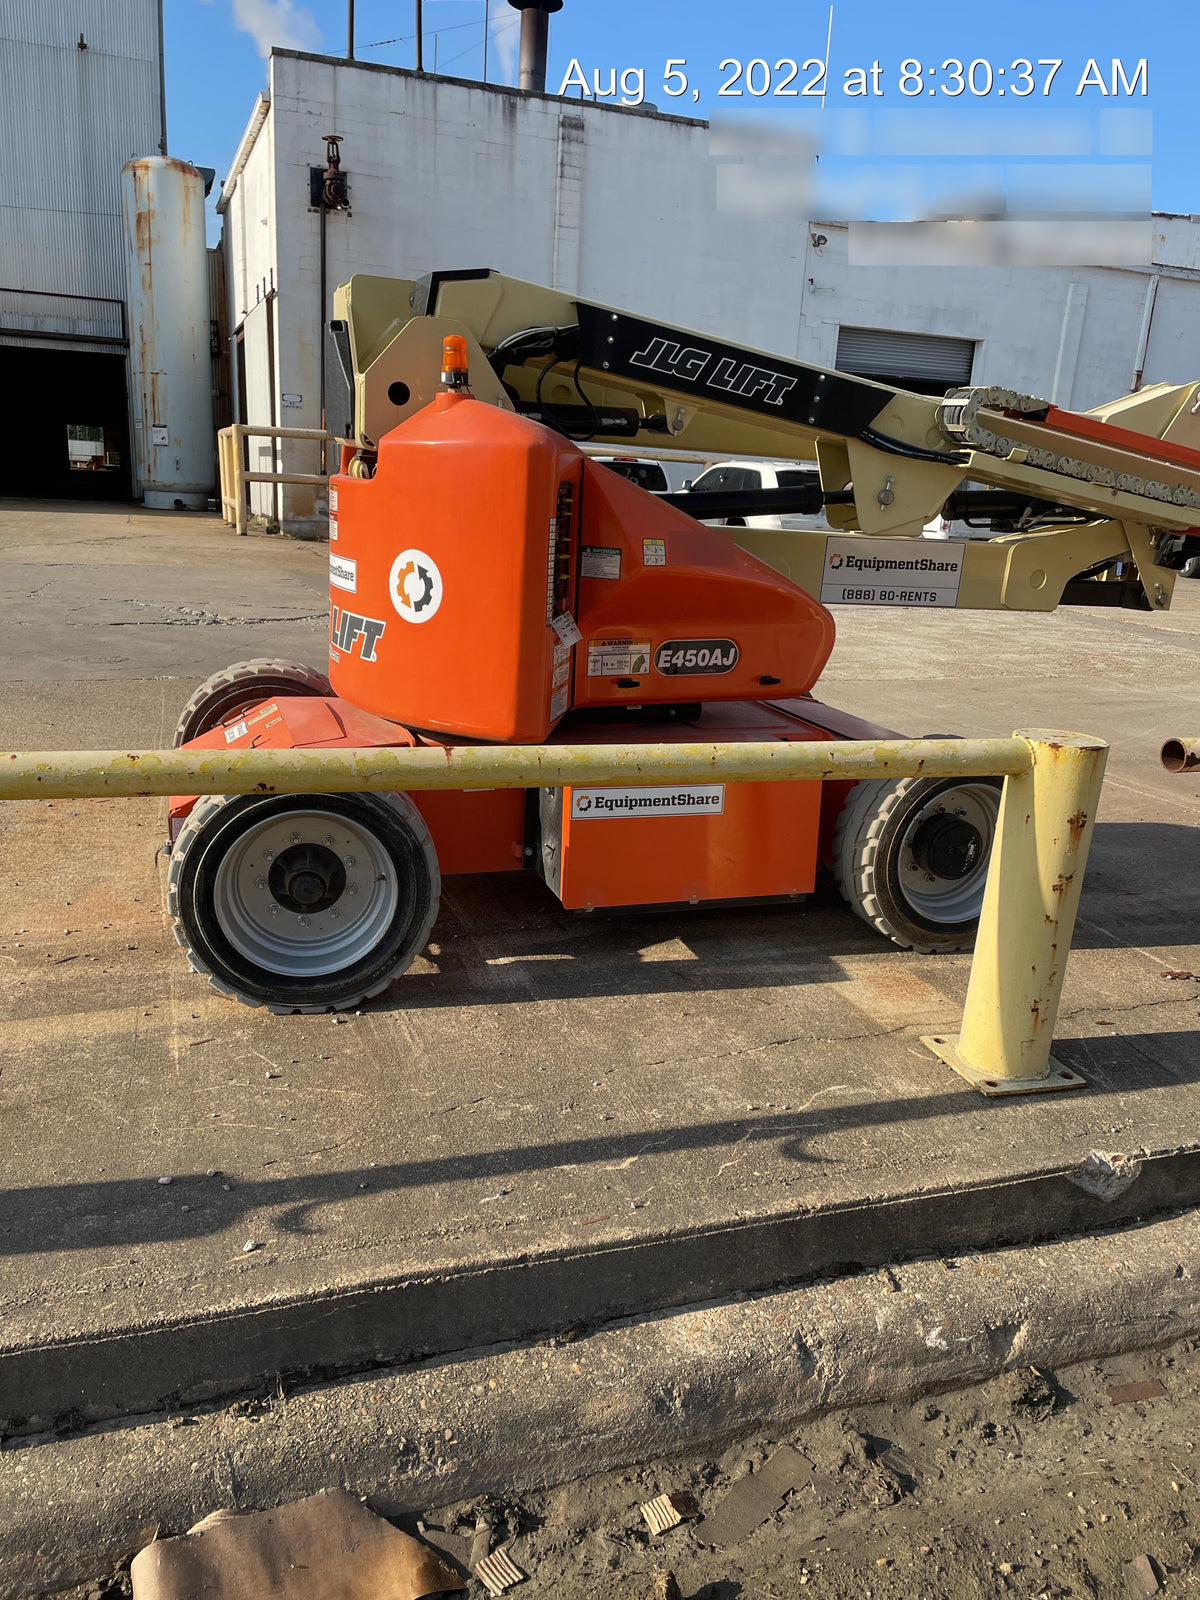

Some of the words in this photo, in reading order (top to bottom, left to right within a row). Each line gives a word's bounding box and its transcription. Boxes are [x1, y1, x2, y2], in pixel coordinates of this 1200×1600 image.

[629, 337, 712, 381] JLG
[706, 357, 798, 406] LIFT
[845, 555, 958, 572] EquipmentShare
[842, 588, 876, 601] (888)
[879, 590, 937, 602] 80-RENTS
[331, 605, 386, 662] LIFT
[657, 647, 736, 668] E450AJ
[594, 794, 720, 811] EquipmentShare
